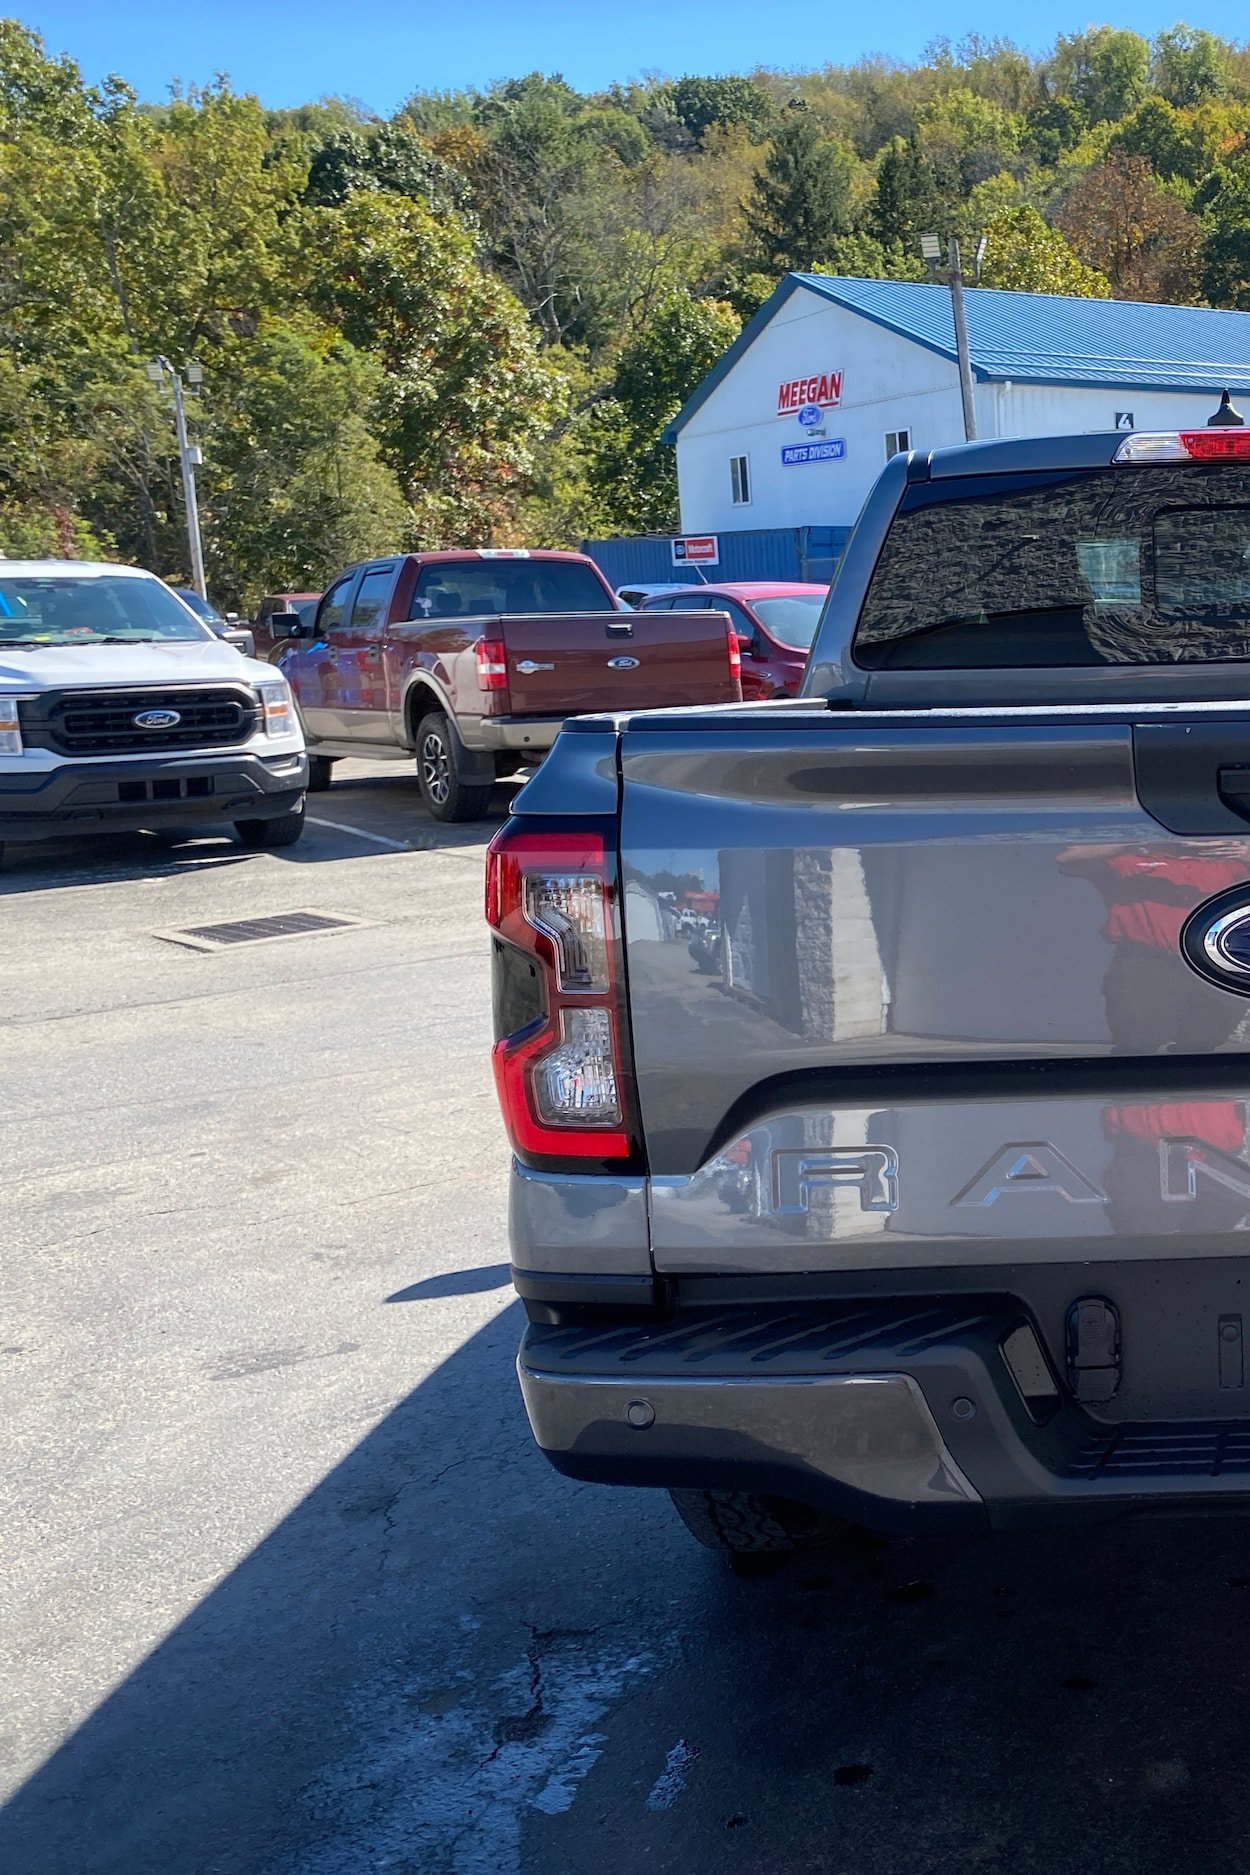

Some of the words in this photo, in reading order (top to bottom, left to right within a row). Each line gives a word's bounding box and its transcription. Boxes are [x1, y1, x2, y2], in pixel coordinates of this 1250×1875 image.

[778, 371, 842, 410] MEEGAN
[801, 408, 818, 425] Ford
[1117, 414, 1132, 429] 4
[784, 447, 809, 464] PARTS
[808, 442, 842, 461] DIVISION
[146, 714, 170, 725] Ford
